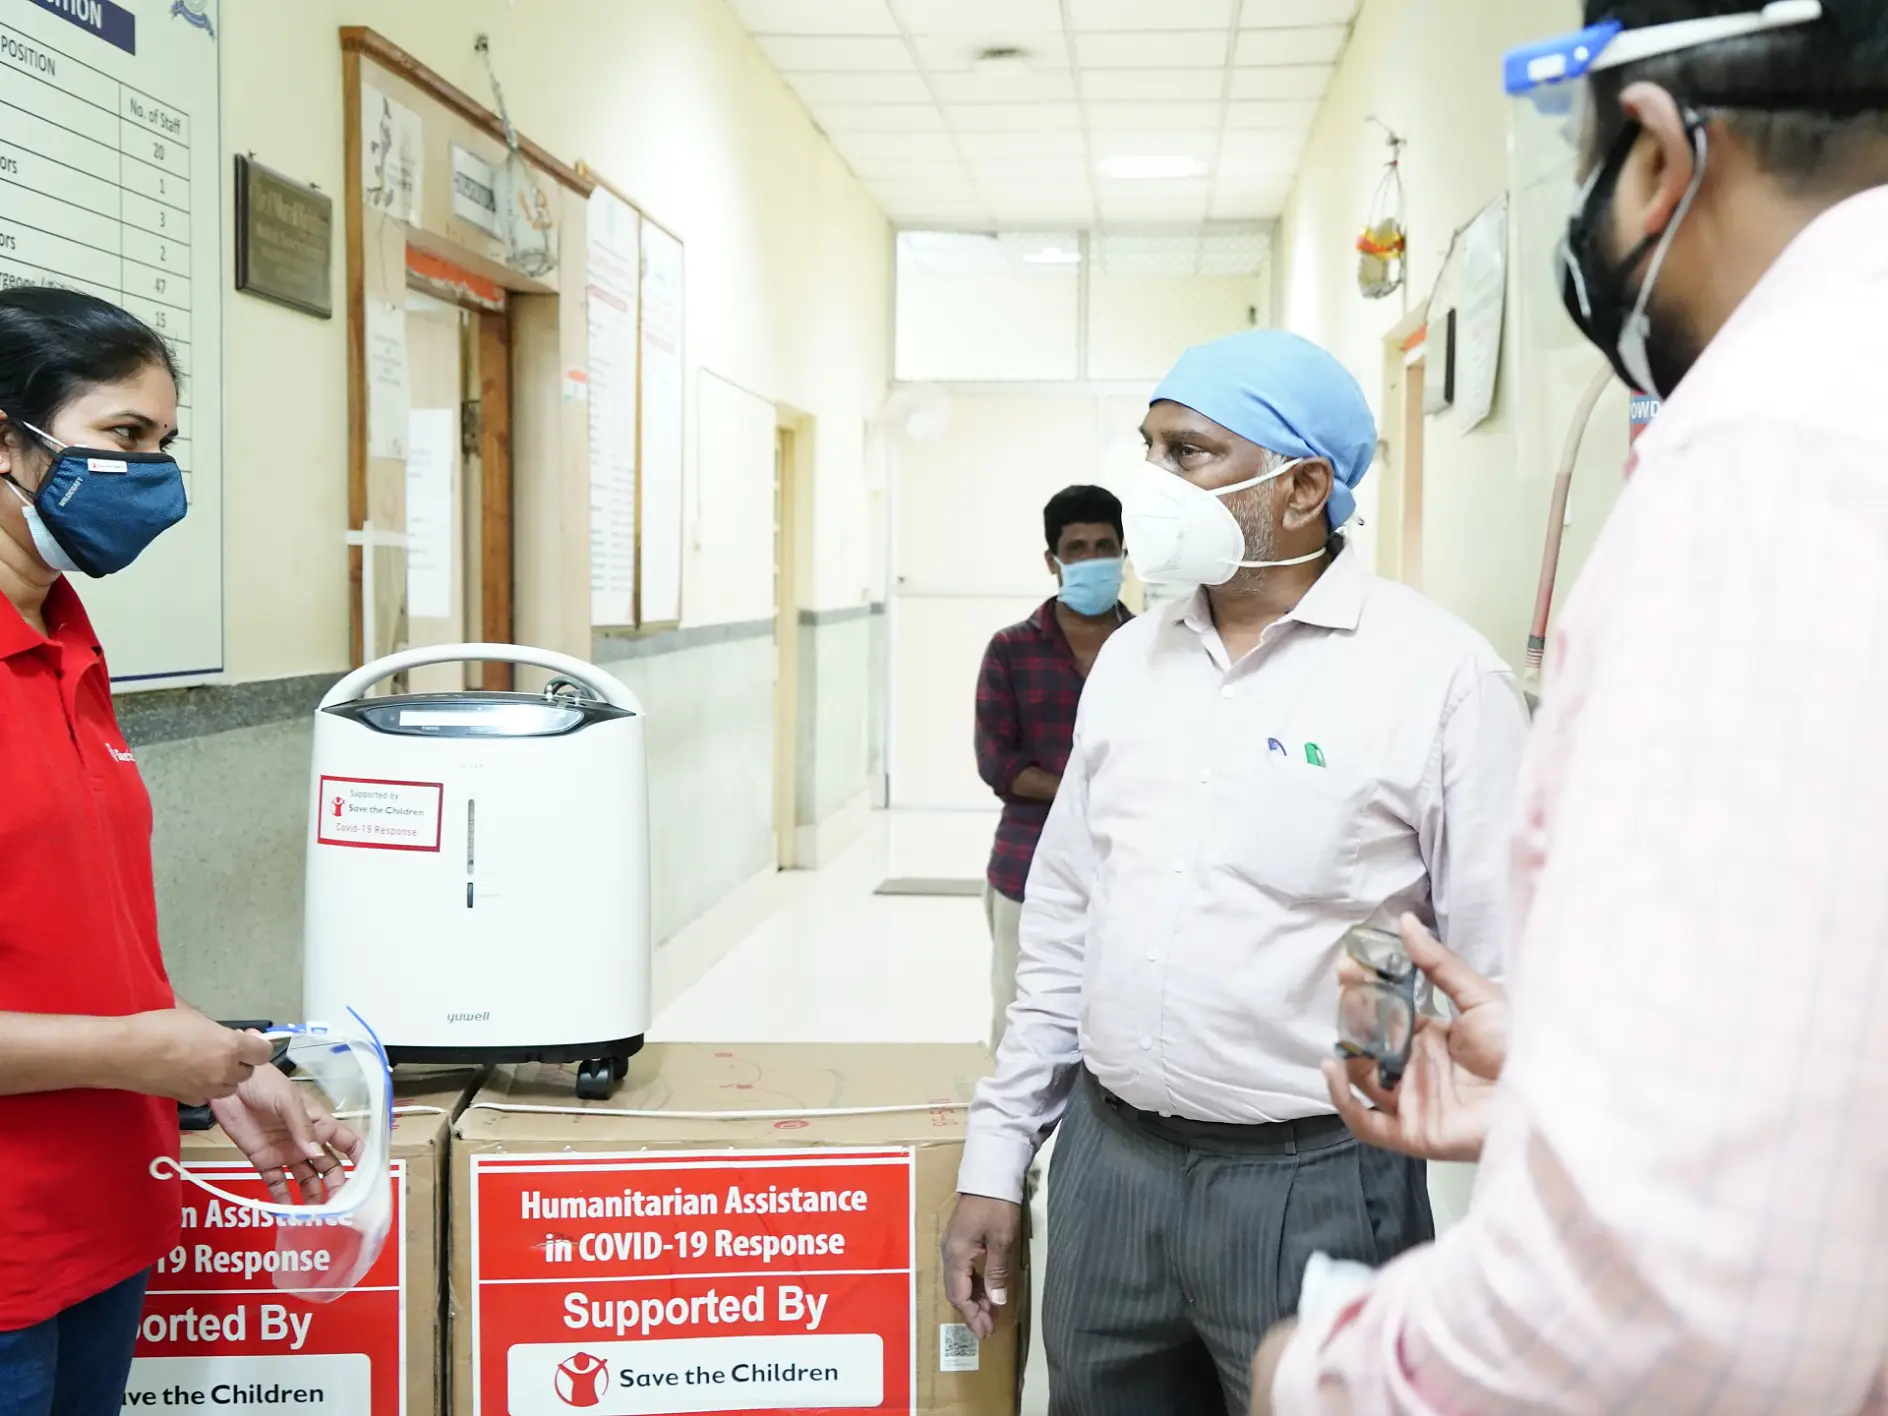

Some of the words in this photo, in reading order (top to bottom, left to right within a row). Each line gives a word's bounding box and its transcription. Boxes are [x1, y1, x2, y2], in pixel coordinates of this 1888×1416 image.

[1, 35, 56, 76] POSITION
[130, 98, 147, 120] No.
[148, 108, 159, 125] of
[160, 112, 180, 136] Staff
[153, 142, 165, 160] 20
[159, 178, 166, 195] 1
[159, 212, 166, 228] 3
[159, 245, 166, 262] 2
[155, 277, 166, 295] 47
[155, 311, 166, 328] 15
[350, 789, 389, 800] Supported
[389, 792, 399, 801] by
[348, 803, 368, 813] Save
[369, 805, 383, 815] the
[385, 806, 425, 816] Children
[336, 822, 372, 834] Covid-19
[374, 824, 417, 837] Response
[447, 1011, 490, 1025] yuwell
[521, 1187, 718, 1219] Humanitarian
[724, 1185, 868, 1215] Assistance
[544, 1233, 573, 1263] in
[578, 1230, 708, 1262] COVID-19
[715, 1229, 846, 1264] Response
[194, 1244, 331, 1280] Response
[563, 1285, 765, 1336] Supported
[777, 1285, 829, 1331] By
[136, 1304, 246, 1343] orted
[260, 1304, 313, 1350] By
[619, 1368, 679, 1388] Save
[685, 1365, 725, 1385] the
[731, 1363, 839, 1383] Children
[162, 1385, 205, 1406] the
[211, 1383, 324, 1405] Children
